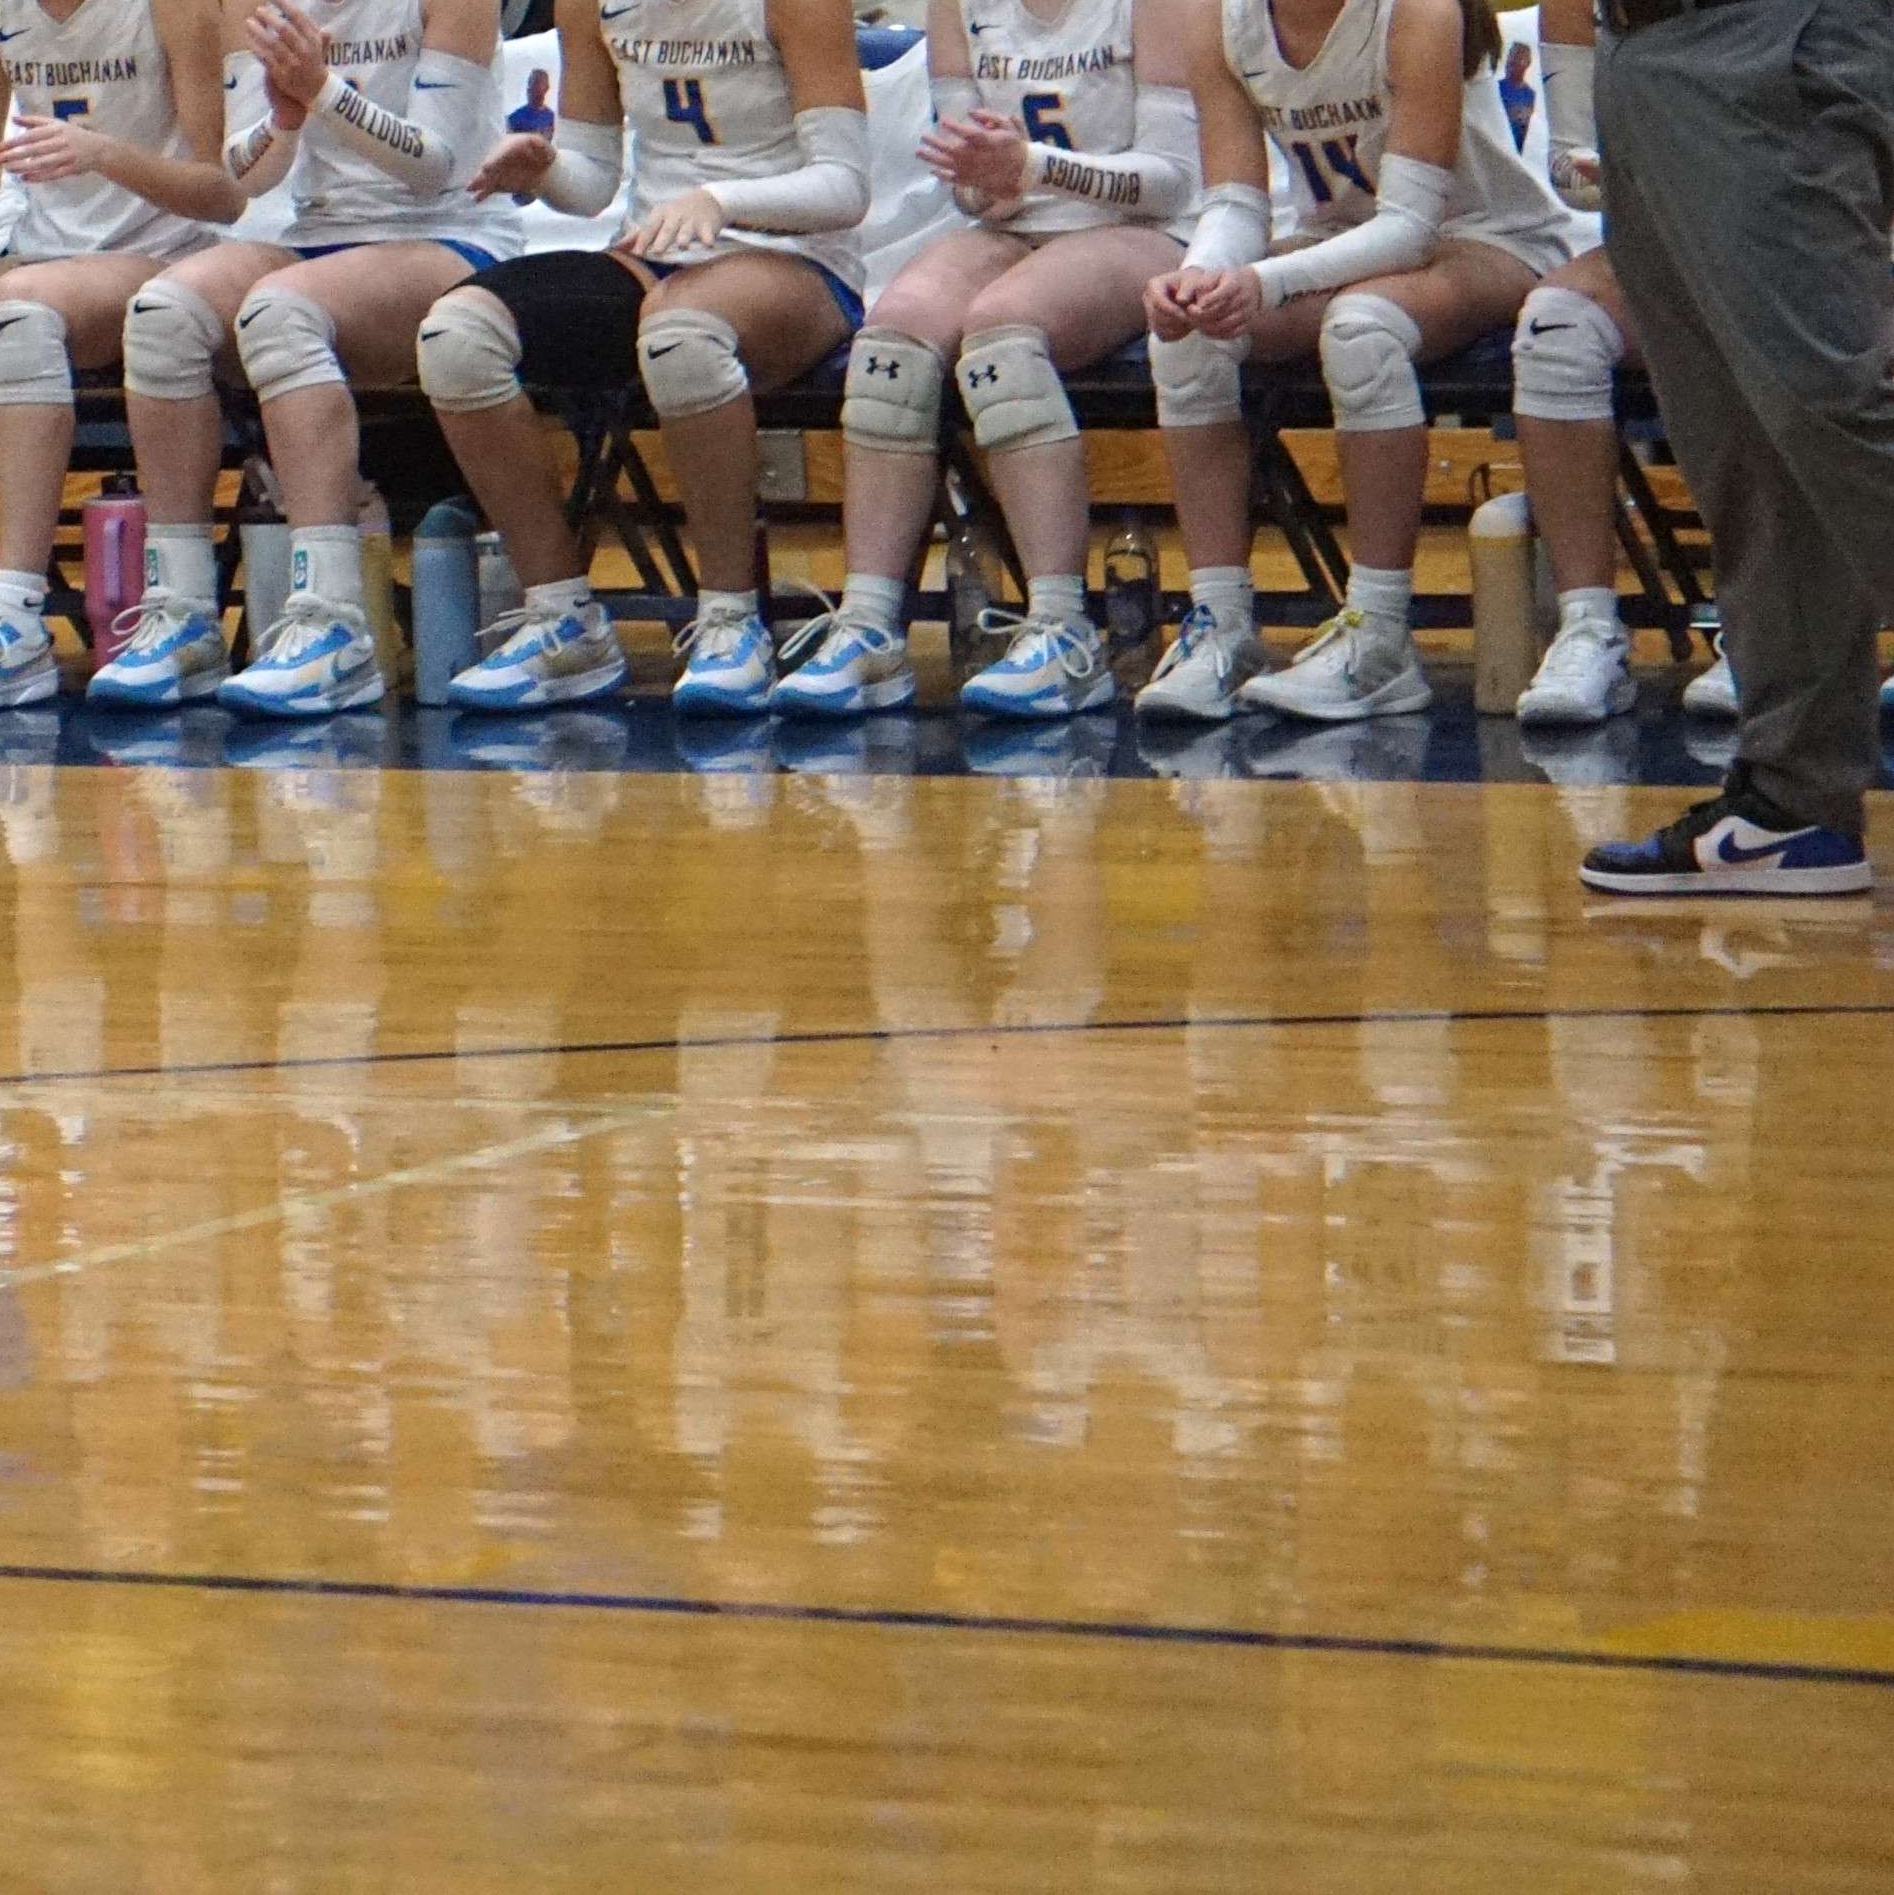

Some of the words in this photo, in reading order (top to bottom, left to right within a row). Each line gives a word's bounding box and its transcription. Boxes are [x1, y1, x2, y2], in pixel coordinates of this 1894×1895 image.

[44, 55, 138, 86] BUCHANAN
[656, 39, 756, 67] BUCHANAN
[1017, 44, 1114, 83] BUCHANAN
[334, 87, 423, 159] BULLDOGS
[662, 79, 722, 147] 4
[1043, 155, 1141, 207] BULLDOGS
[1291, 133, 1379, 203] 14
